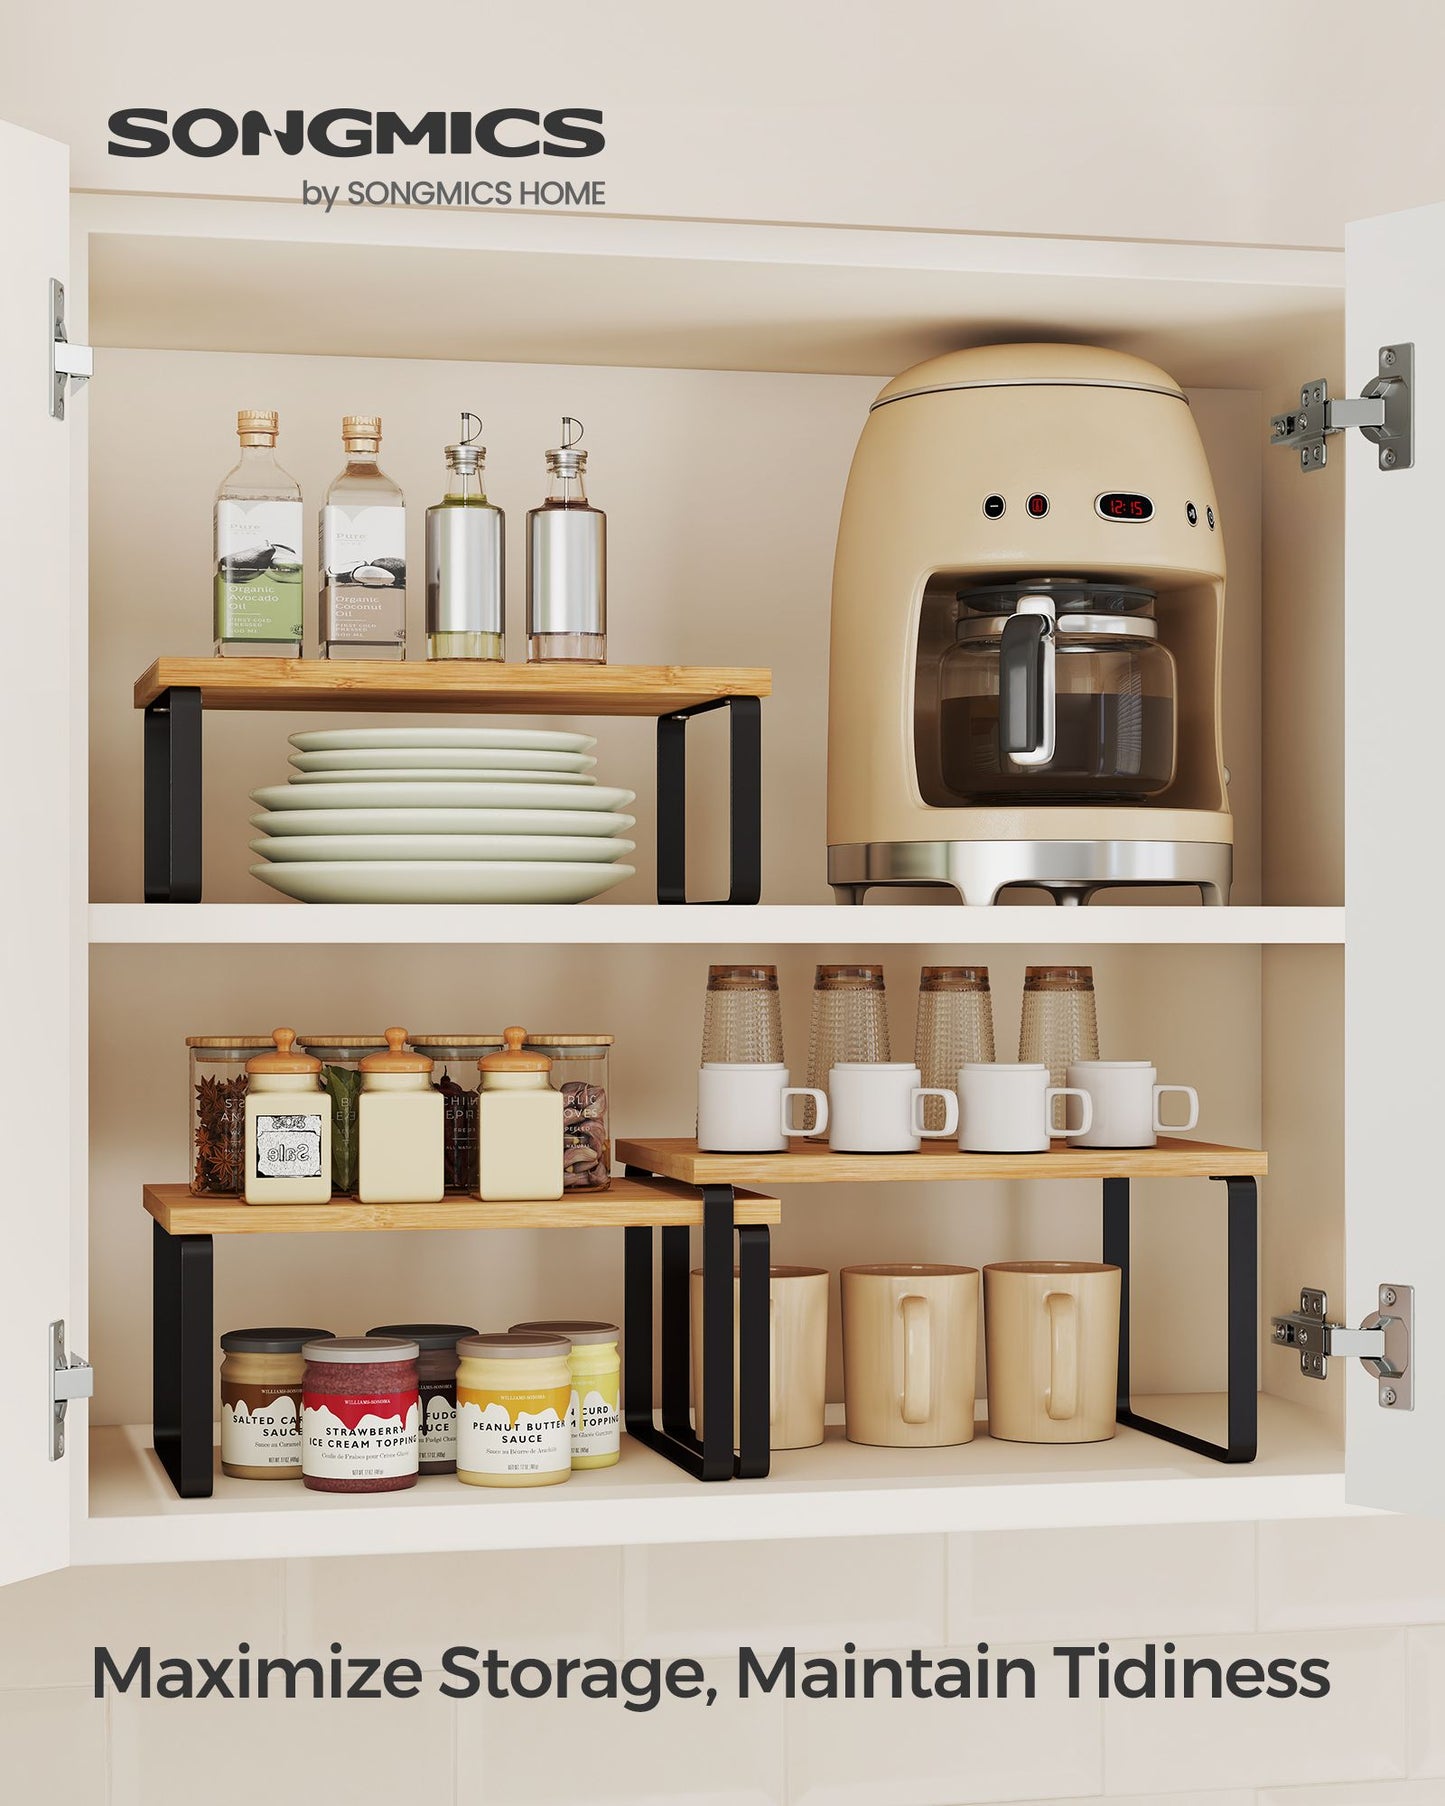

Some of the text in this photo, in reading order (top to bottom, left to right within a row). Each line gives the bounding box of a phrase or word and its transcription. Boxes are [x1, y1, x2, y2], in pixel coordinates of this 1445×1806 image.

[1110, 500, 1143, 515] 12:15
[229, 585, 274, 593] Organic
[230, 594, 279, 602] Avocado
[336, 595, 380, 603] Organic
[567, 1094, 597, 1105] RLIC
[563, 1108, 598, 1118] OVES
[582, 1406, 609, 1415] CURD
[232, 1415, 275, 1425] SALTED
[426, 1411, 456, 1420] FUDG
[418, 1423, 449, 1432] AUCE
[473, 1422, 520, 1431] PEANUT
[526, 1420, 565, 1431] BUTTER
[263, 1428, 303, 1437] SAUCE
[326, 1426, 405, 1436] STRAWBERRY
[309, 1437, 323, 1447] ICE
[327, 1440, 370, 1448] CREAM
[501, 1434, 543, 1443] SAUCE
